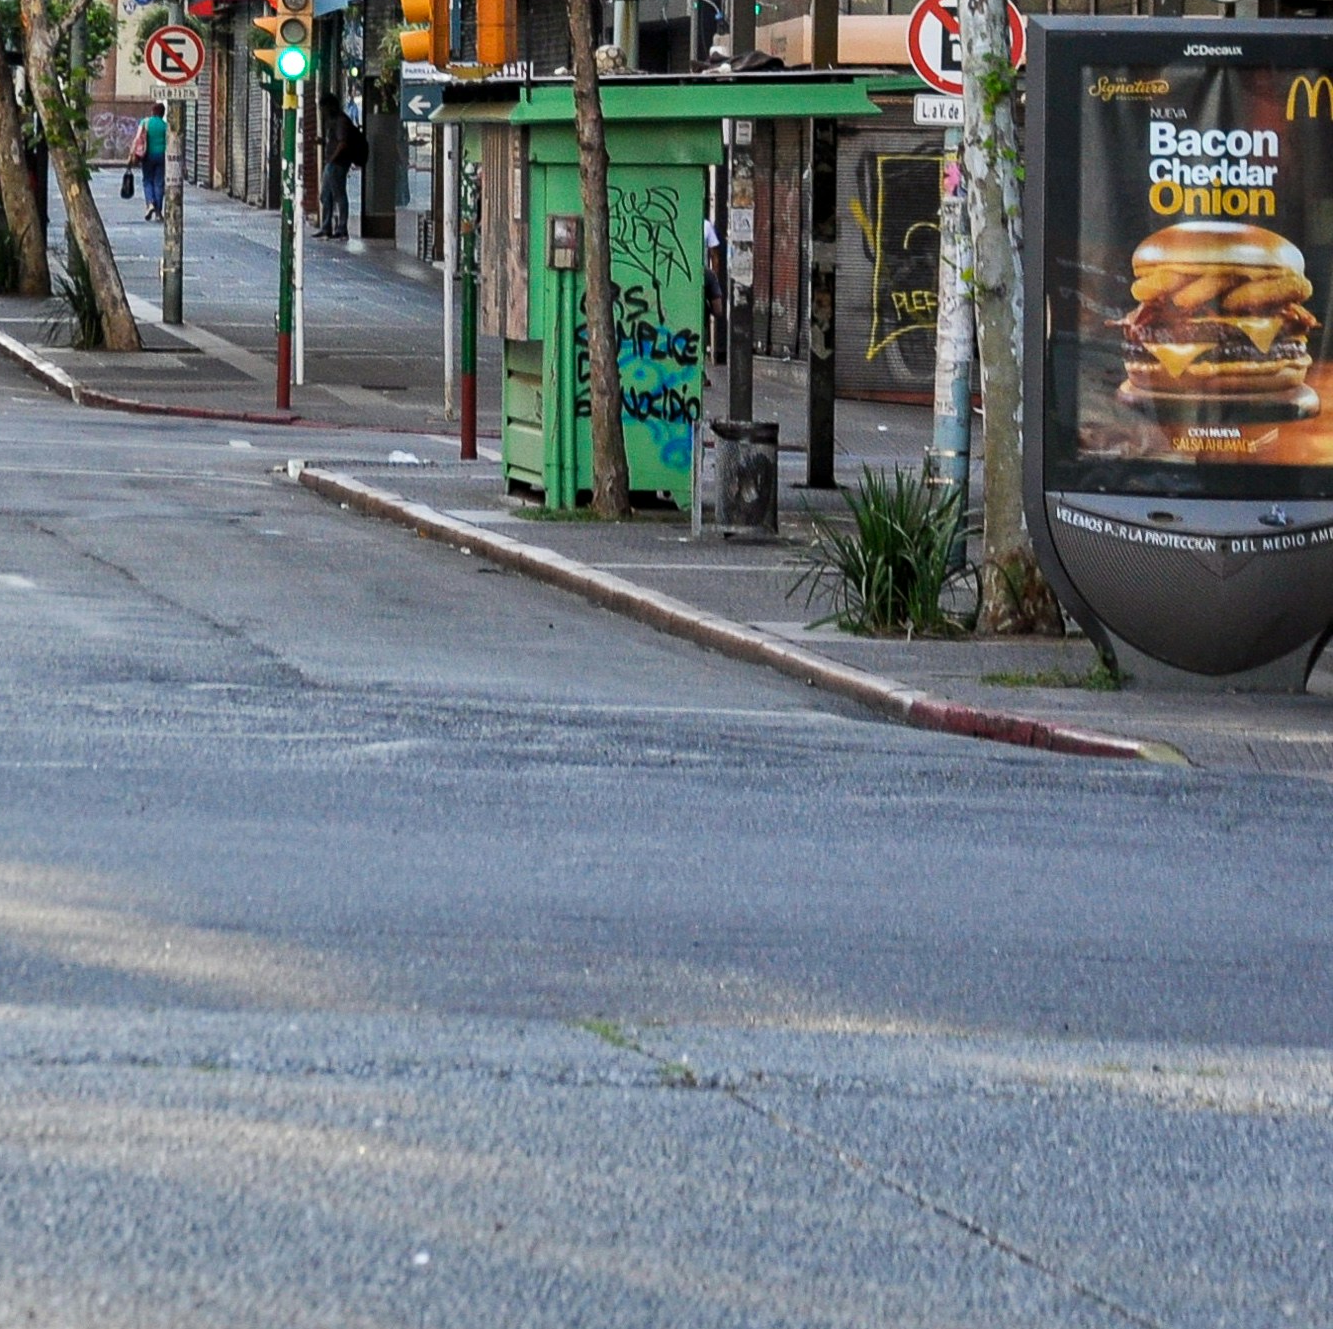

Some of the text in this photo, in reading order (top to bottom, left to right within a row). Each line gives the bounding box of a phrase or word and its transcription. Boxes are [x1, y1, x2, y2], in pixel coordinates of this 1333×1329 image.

[1183, 44, 1243, 56] JCDecaux
[1089, 76, 1170, 101] Signature
[948, 104, 959, 119] de
[1150, 108, 1187, 119] NUEVA
[1149, 121, 1279, 157] Bacon
[1148, 158, 1278, 186] Cheddar
[1148, 178, 1276, 216] Onion
[1172, 439, 1203, 451] SALSA
[1128, 529, 1143, 543] LA
[1231, 539, 1257, 552] DEL
[1263, 533, 1306, 550] MEDIO
